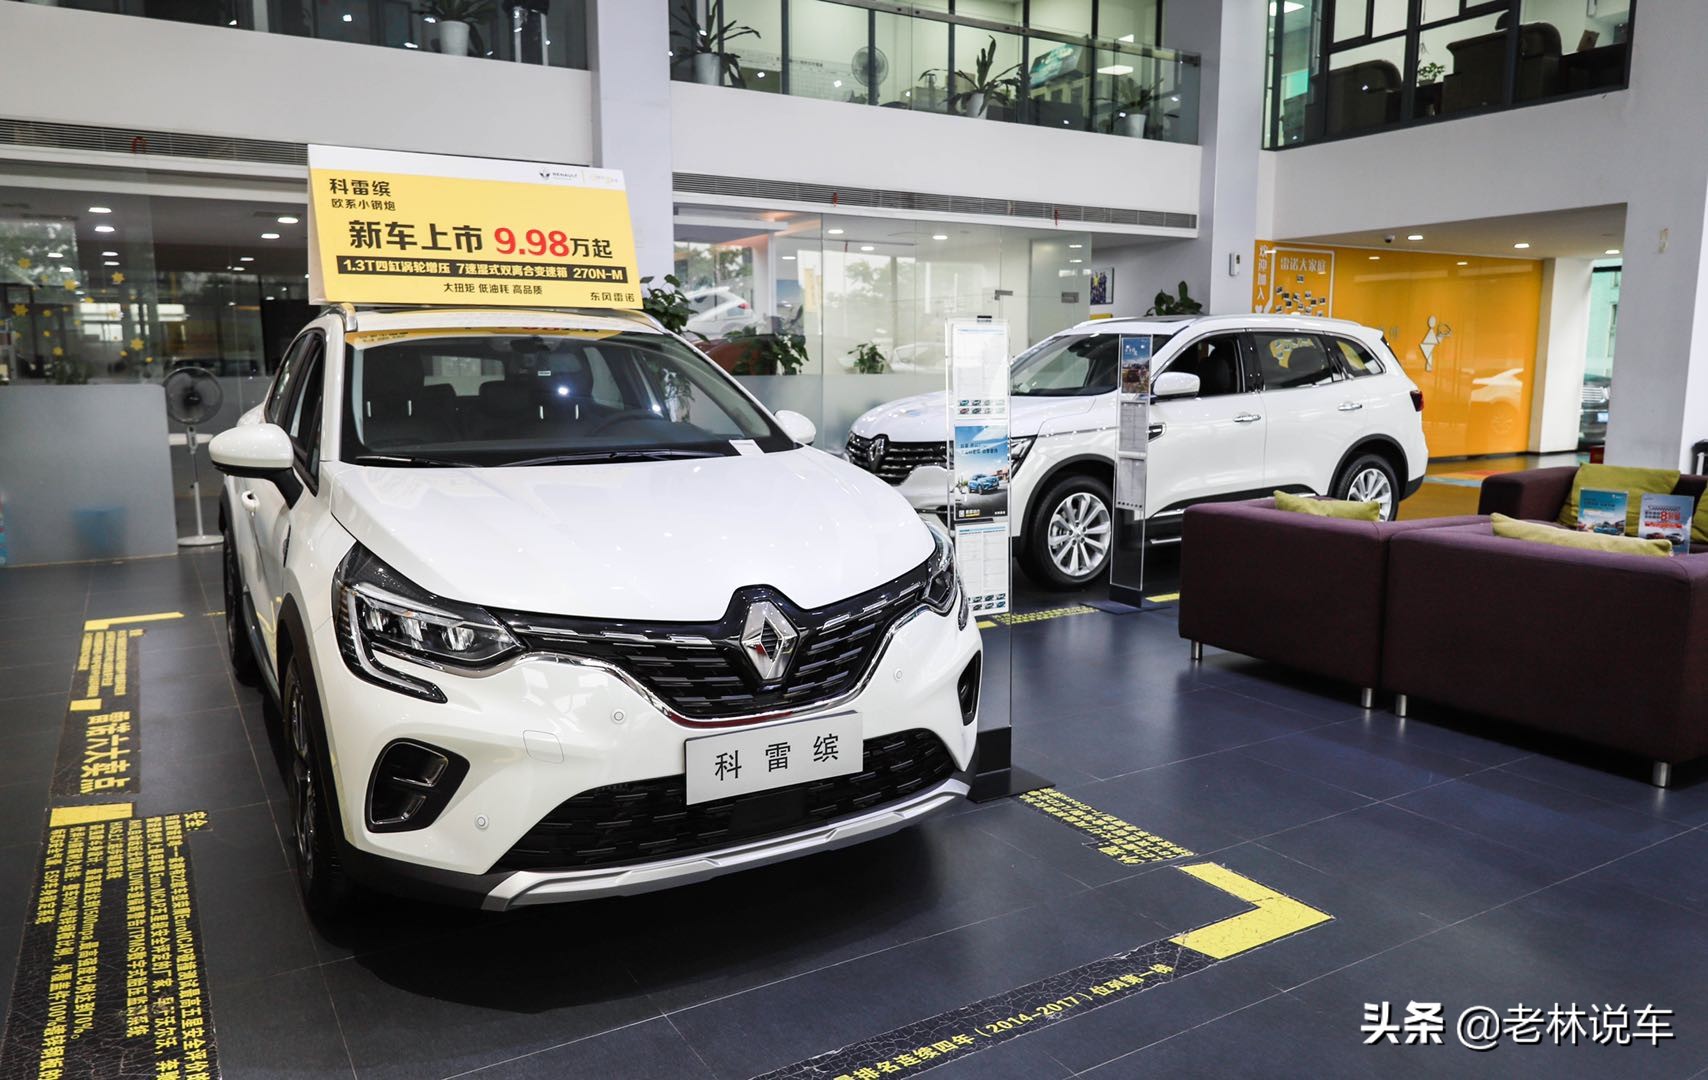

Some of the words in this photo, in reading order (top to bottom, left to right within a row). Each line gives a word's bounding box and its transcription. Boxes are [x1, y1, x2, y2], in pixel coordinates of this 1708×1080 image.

[329, 178, 391, 197] 科雷缤
[331, 198, 396, 212] 欧系小钢炮
[348, 219, 482, 252] 新车上市
[494, 227, 613, 259] 9.98万起
[343, 260, 451, 274] 1.3T四缸涡轮增压
[455, 263, 568, 279] 7速湿式双离合变速箱
[573, 267, 624, 280] 270N-M
[1280, 256, 1327, 273] 雷诺大家庭
[443, 282, 476, 293] 大扭矩
[478, 283, 510, 294] 低油耗
[512, 285, 544, 295] 高品质
[590, 291, 636, 303] 东风雷诺
[80, 711, 131, 794] 雷诺六大卖点
[714, 733, 839, 781] 科雷缤
